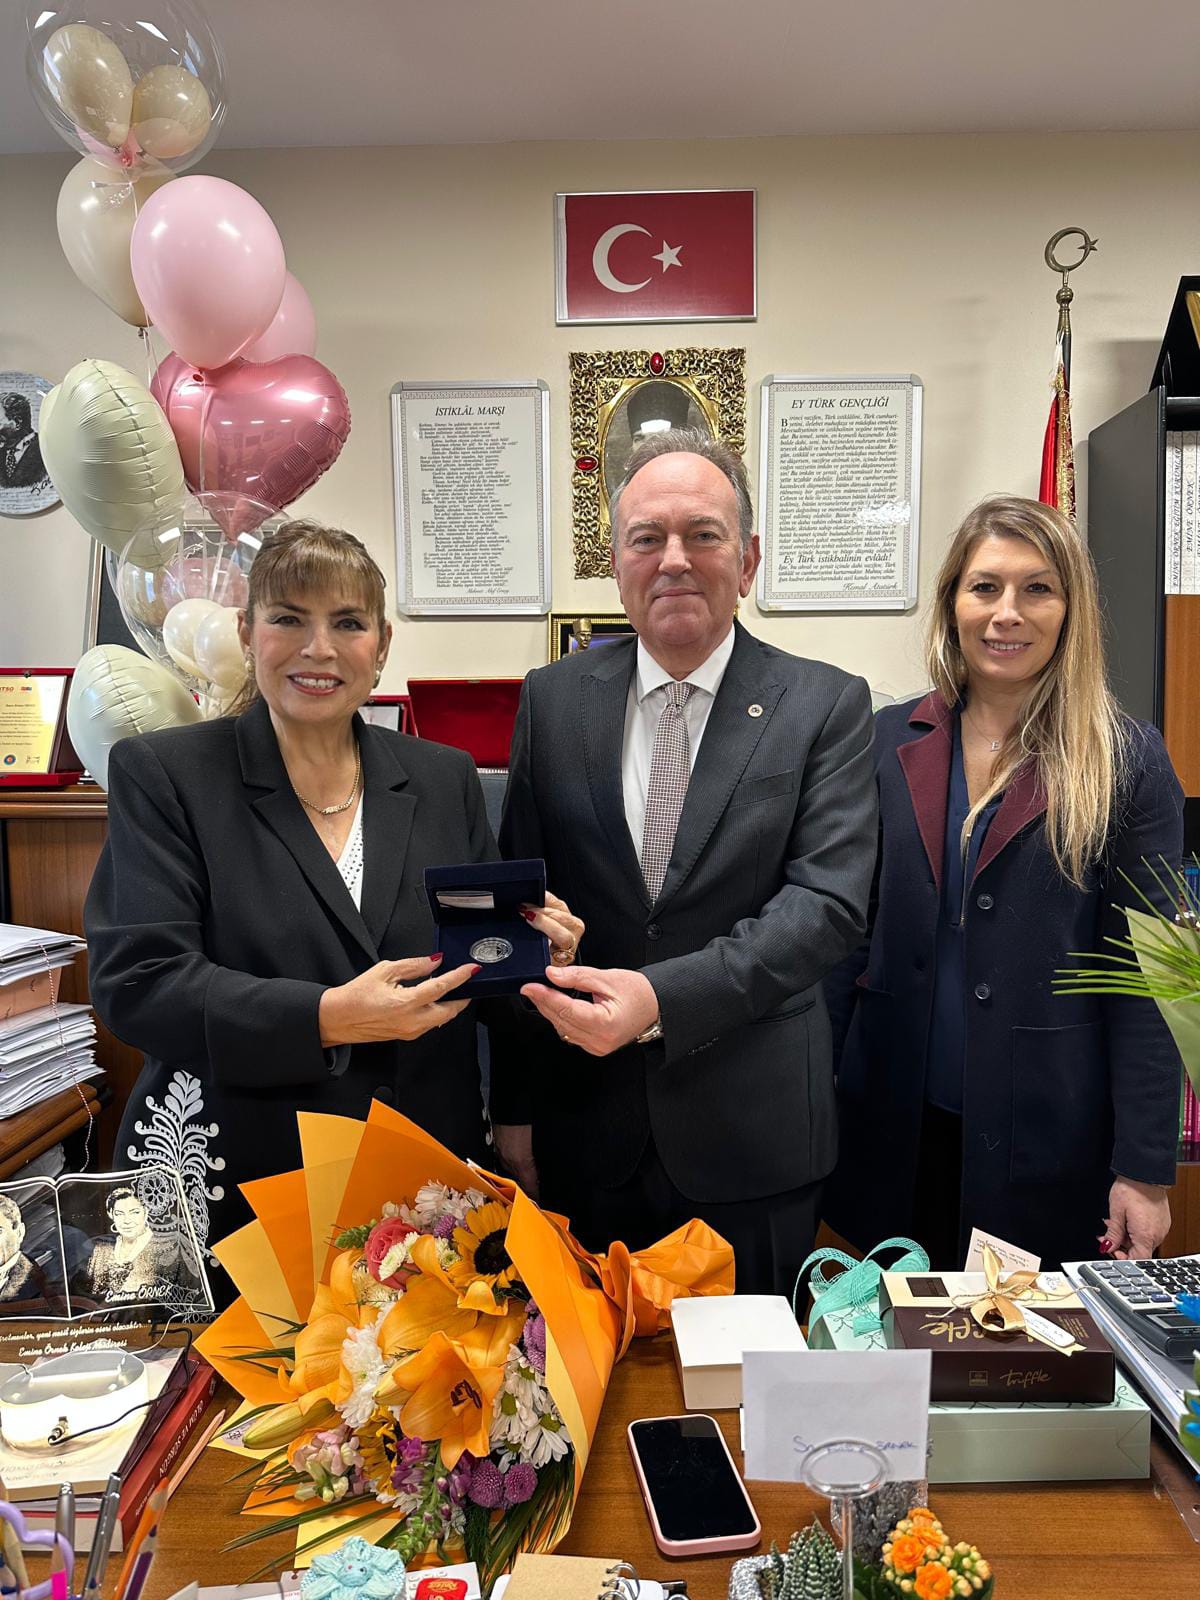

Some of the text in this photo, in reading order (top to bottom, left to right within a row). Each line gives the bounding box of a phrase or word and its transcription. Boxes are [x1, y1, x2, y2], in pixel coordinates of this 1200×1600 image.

[792, 396, 889, 410] EY TÜRK GENÇLİĞİ
[435, 406, 505, 417] İSTİKLÂL MARŞI
[783, 553, 892, 566] Ey Türk istikbalinin evlâdı!
[1000, 1368, 1052, 1388] truffle
